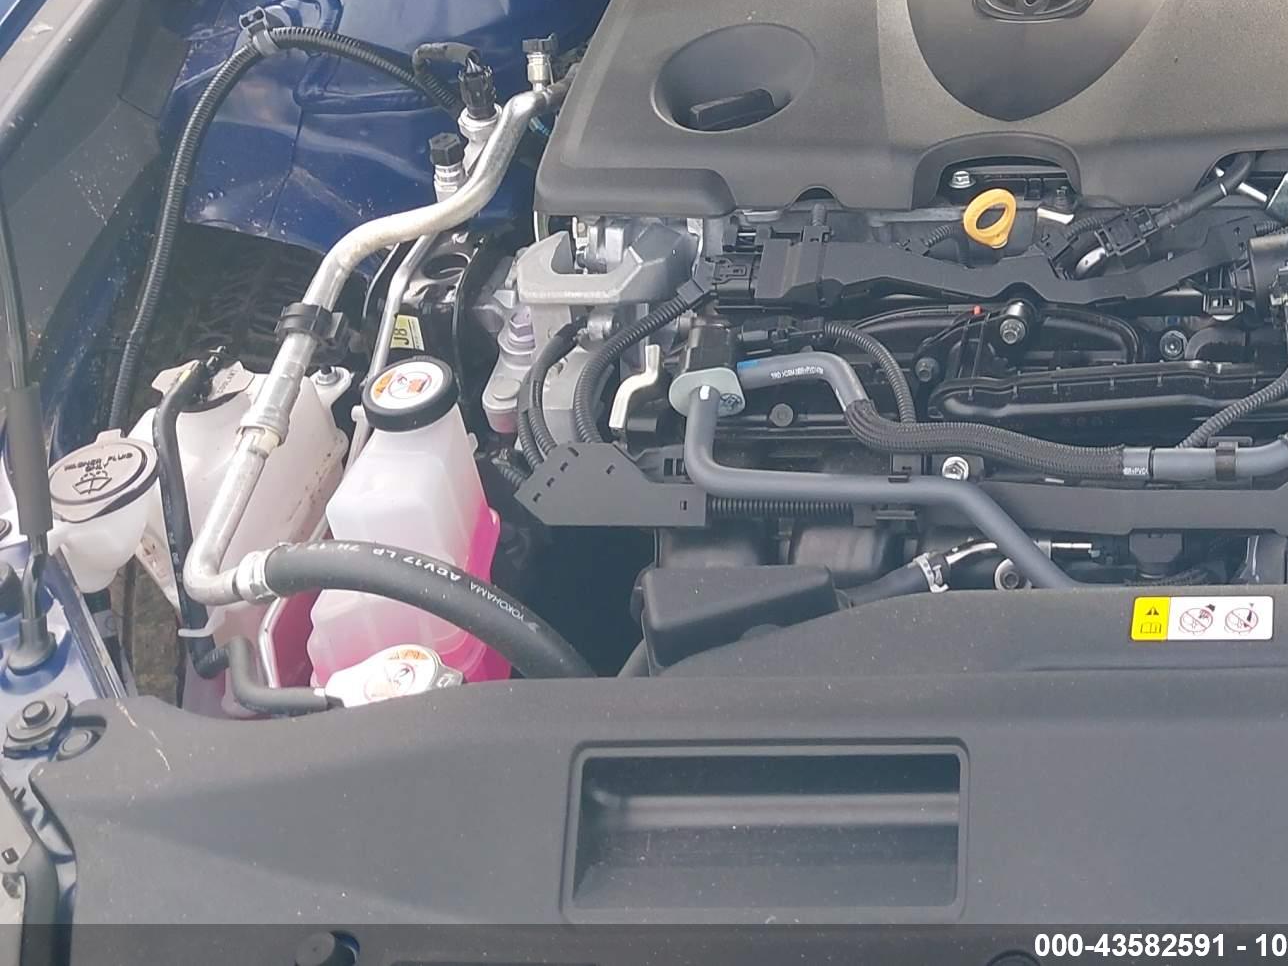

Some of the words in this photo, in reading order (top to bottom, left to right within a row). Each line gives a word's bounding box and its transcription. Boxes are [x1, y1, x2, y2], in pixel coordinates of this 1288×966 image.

[372, 547, 397, 560] LP
[402, 553, 463, 582] ACV17
[470, 581, 525, 622] YOKOHAMA
